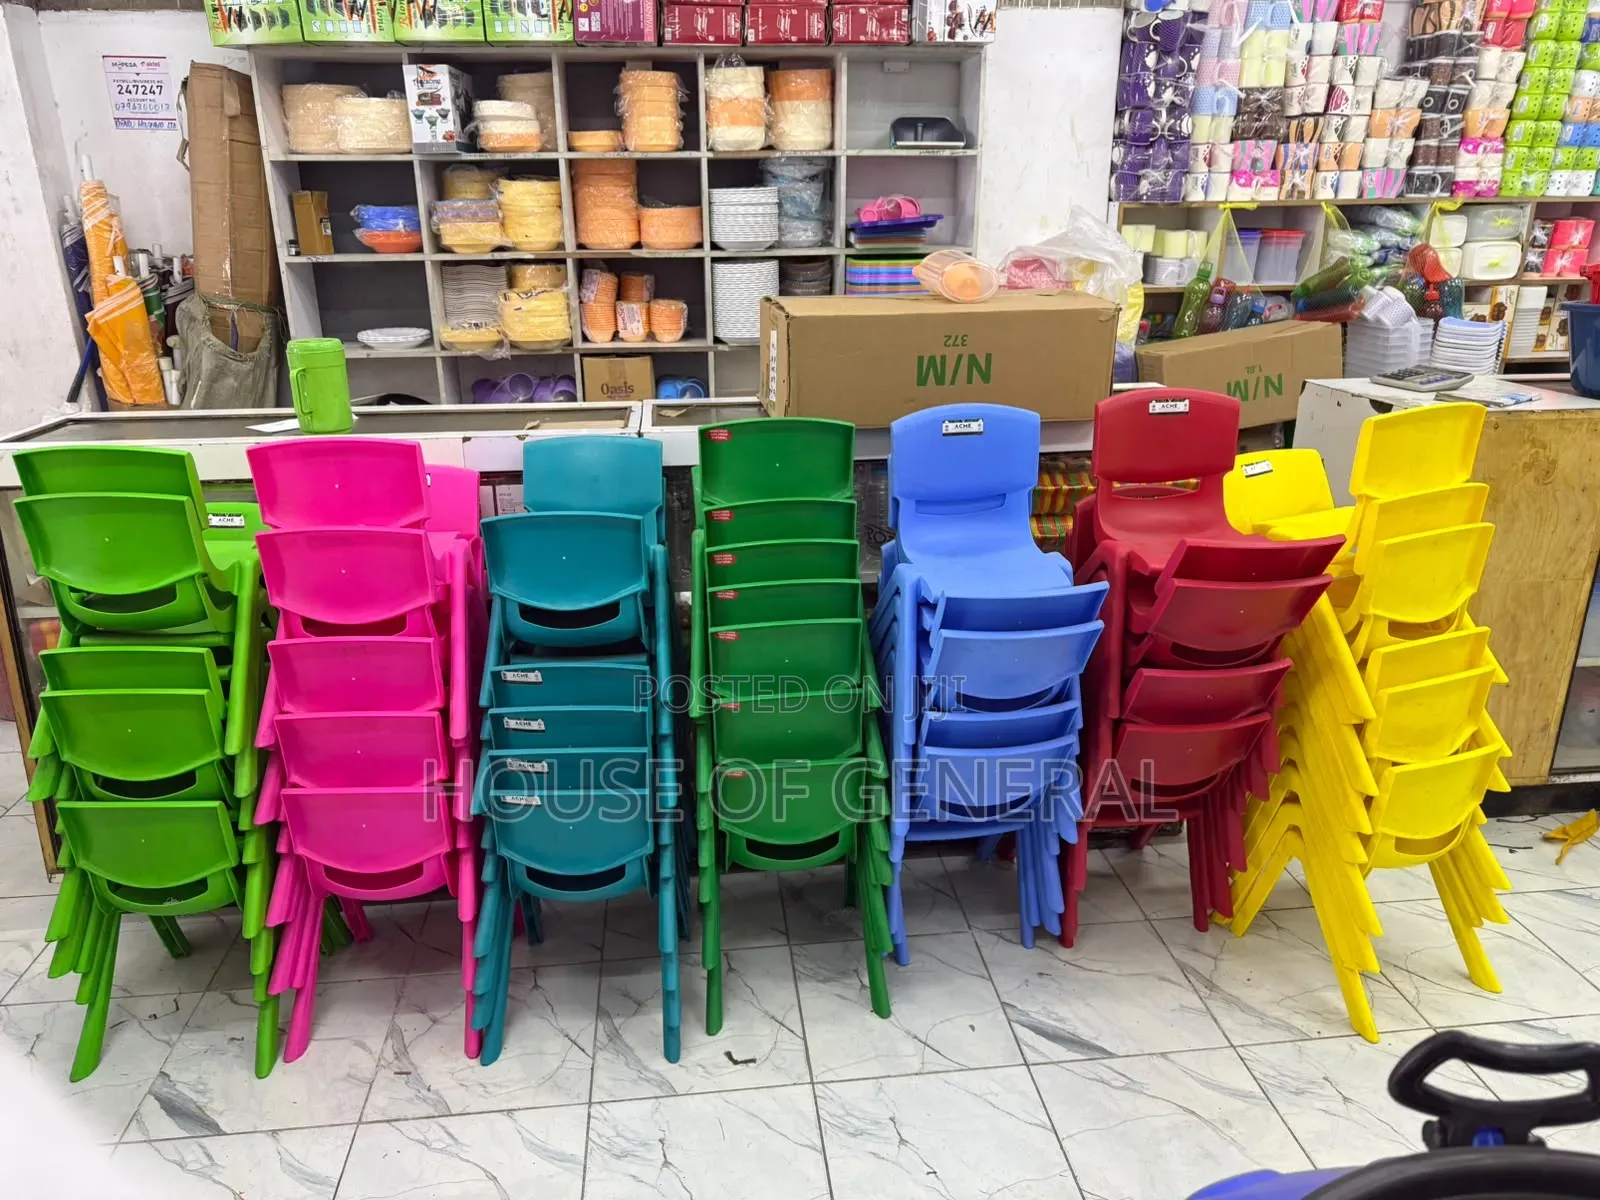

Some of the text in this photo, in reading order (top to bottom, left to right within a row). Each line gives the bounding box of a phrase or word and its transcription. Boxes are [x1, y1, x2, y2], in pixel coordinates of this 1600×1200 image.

[116, 84, 163, 96] 247247
[943, 334, 969, 348] 372
[916, 352, 993, 387] N/M
[601, 380, 635, 396] Oasis
[1226, 372, 1284, 402] N/M
